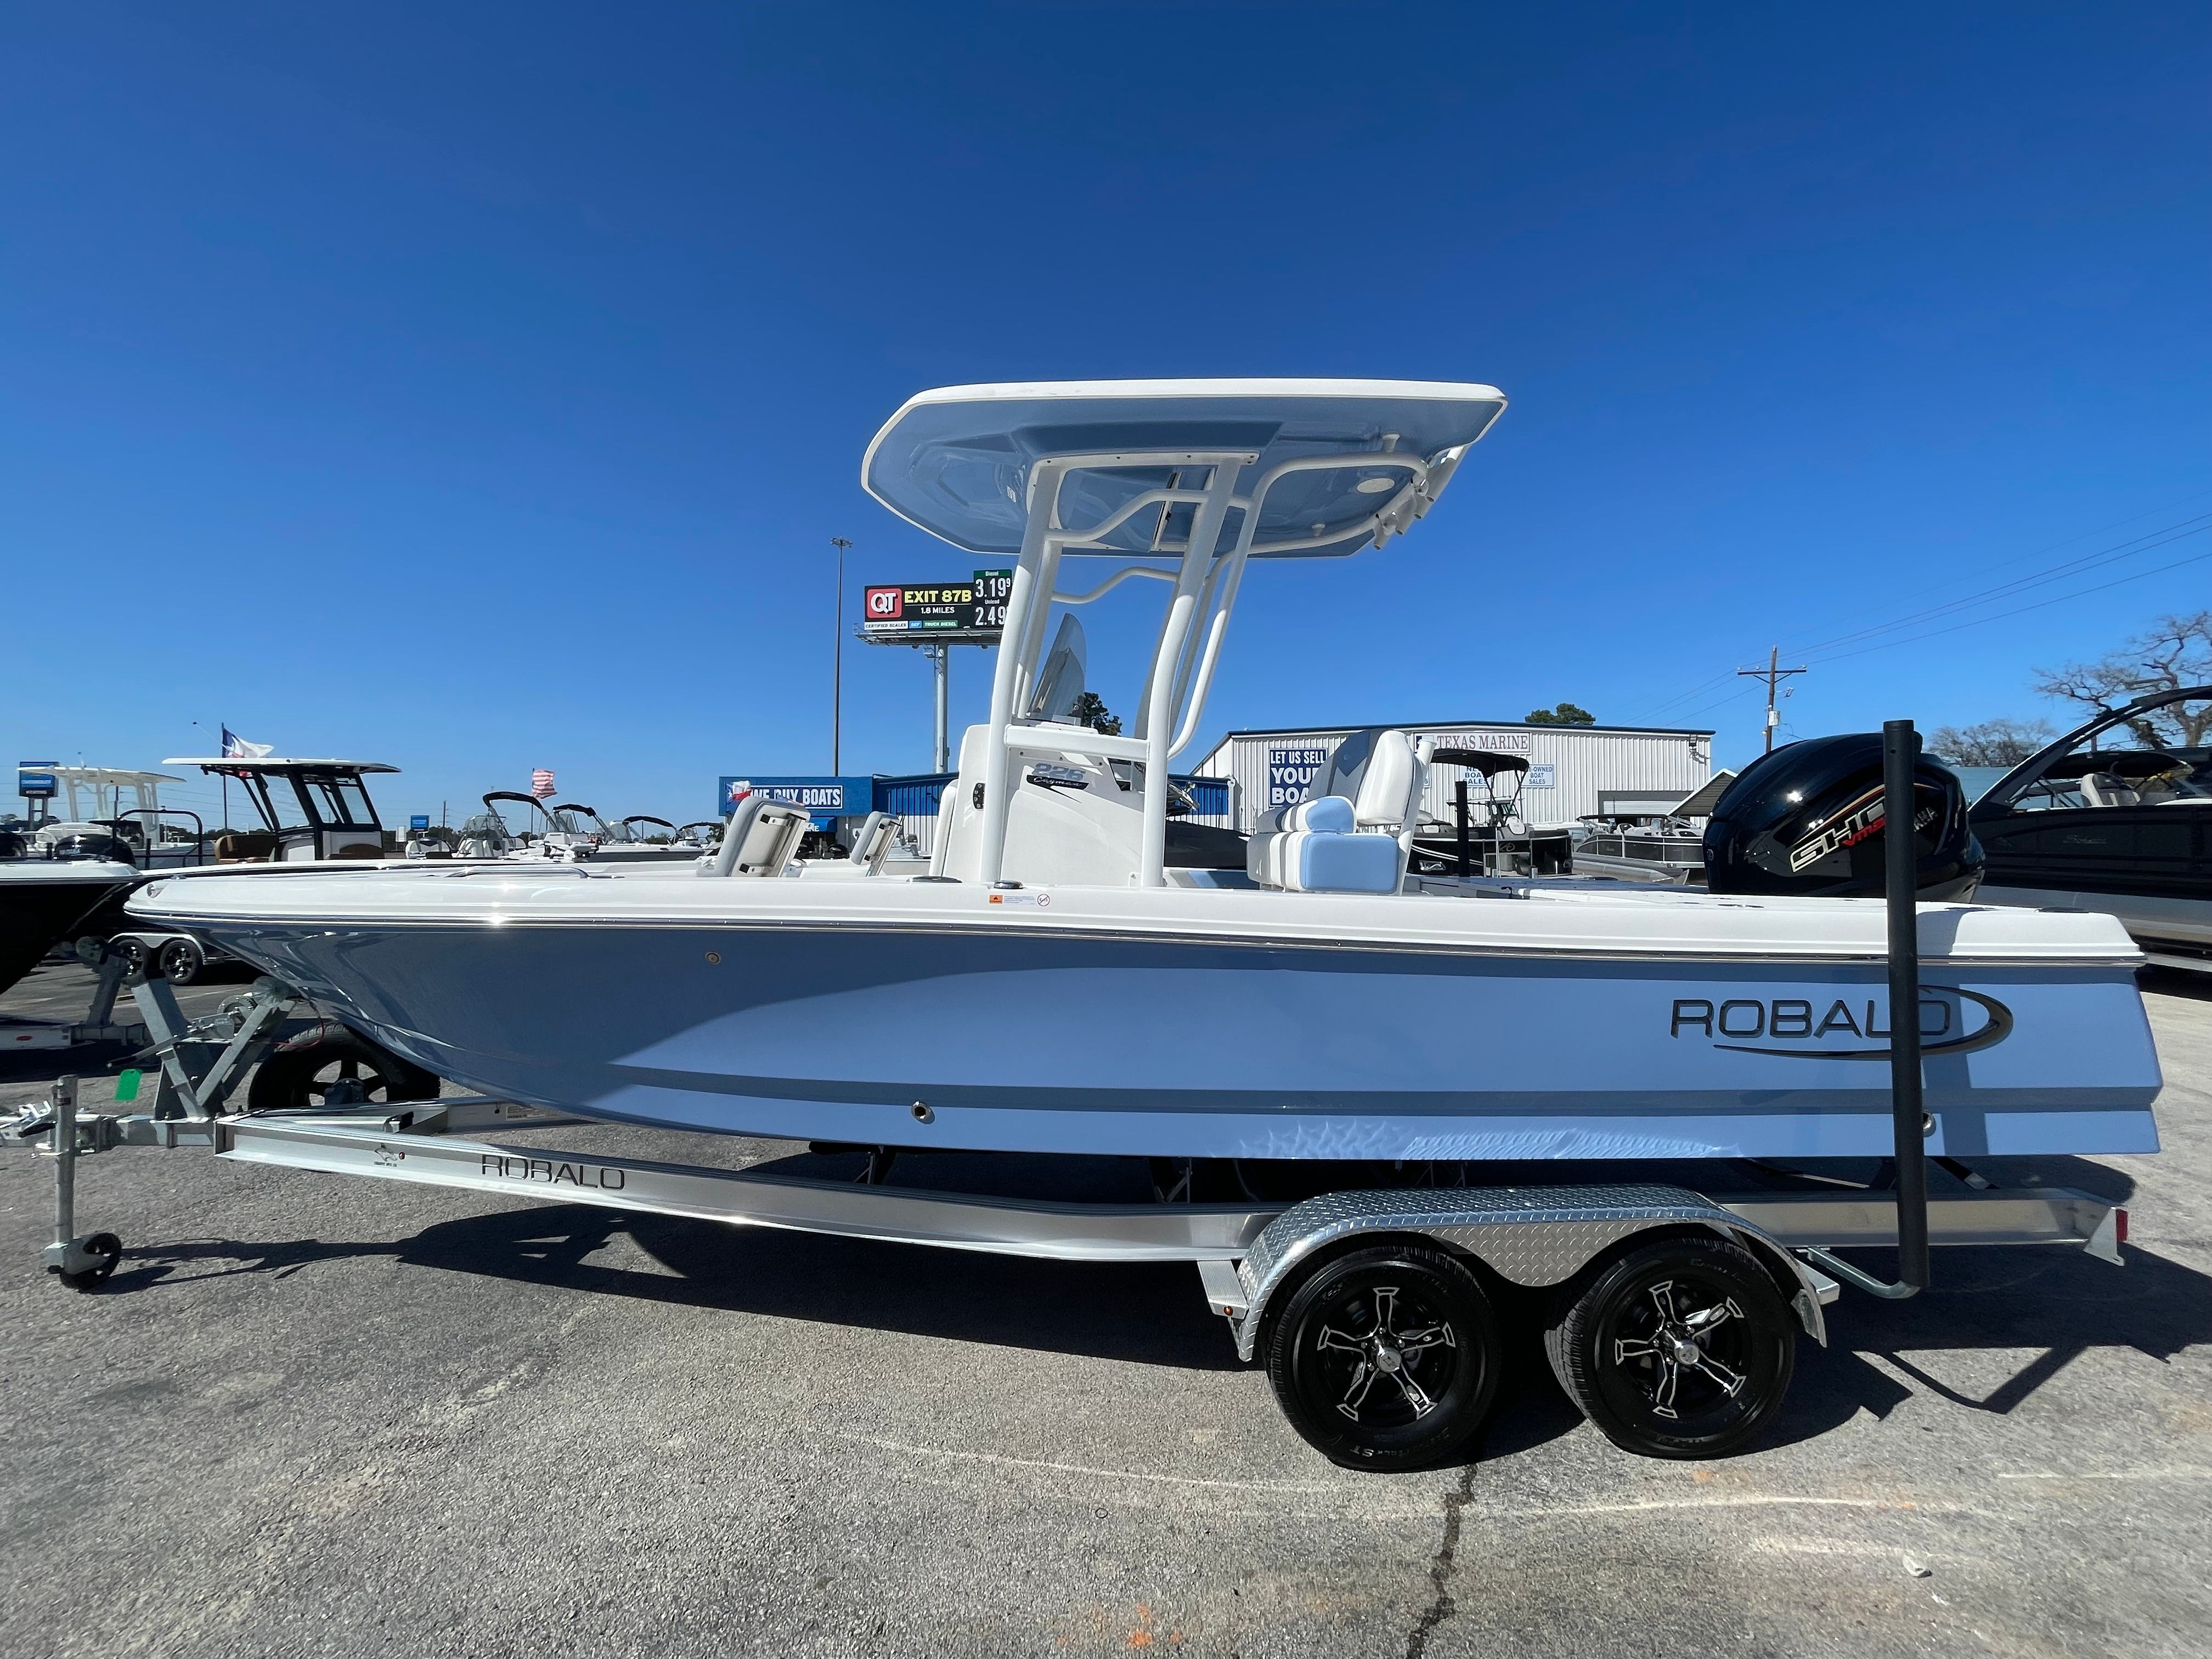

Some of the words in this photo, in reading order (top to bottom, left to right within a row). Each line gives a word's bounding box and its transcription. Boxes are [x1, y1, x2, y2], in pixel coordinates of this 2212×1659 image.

[870, 592, 896, 613] QT
[904, 590, 939, 603] EXIT
[941, 590, 972, 603] 87B
[975, 606, 1007, 625] 2.49
[1437, 735, 1476, 749] TEXAS
[1479, 735, 1528, 749] MARINE
[1270, 751, 1286, 764] LET
[1289, 751, 1301, 764] US
[1304, 751, 1325, 764] SELL
[1032, 763, 1086, 781] 226
[1034, 776, 1083, 787] Cayman
[802, 788, 841, 805] BOATS
[1272, 787, 1310, 804] BOA
[481, 1154, 625, 1191] ROBALO
